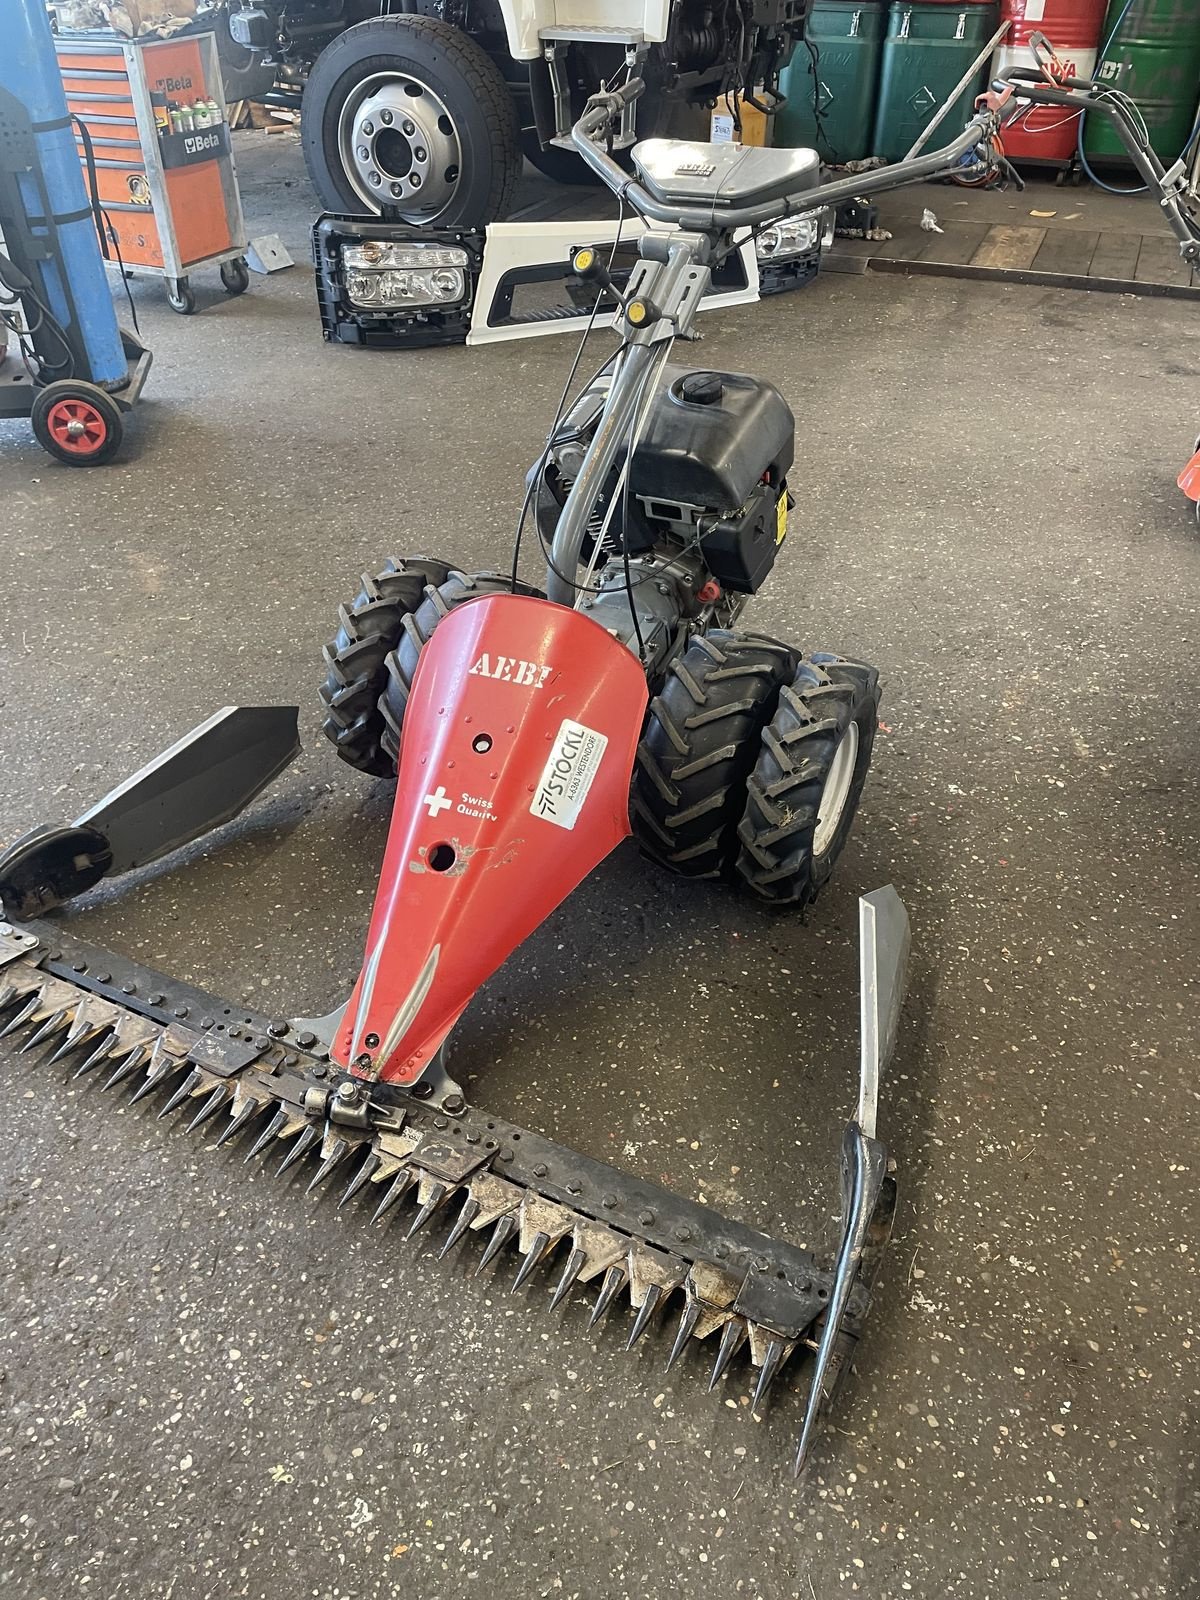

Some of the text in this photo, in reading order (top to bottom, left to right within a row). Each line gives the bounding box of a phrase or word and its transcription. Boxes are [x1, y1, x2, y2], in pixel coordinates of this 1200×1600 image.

[166, 76, 193, 92] Beta
[195, 133, 220, 151] Beta
[469, 653, 552, 689] AEBI
[568, 777, 581, 801] A-6363
[576, 735, 597, 777] WESTENDORF
[461, 793, 493, 809] Swiss
